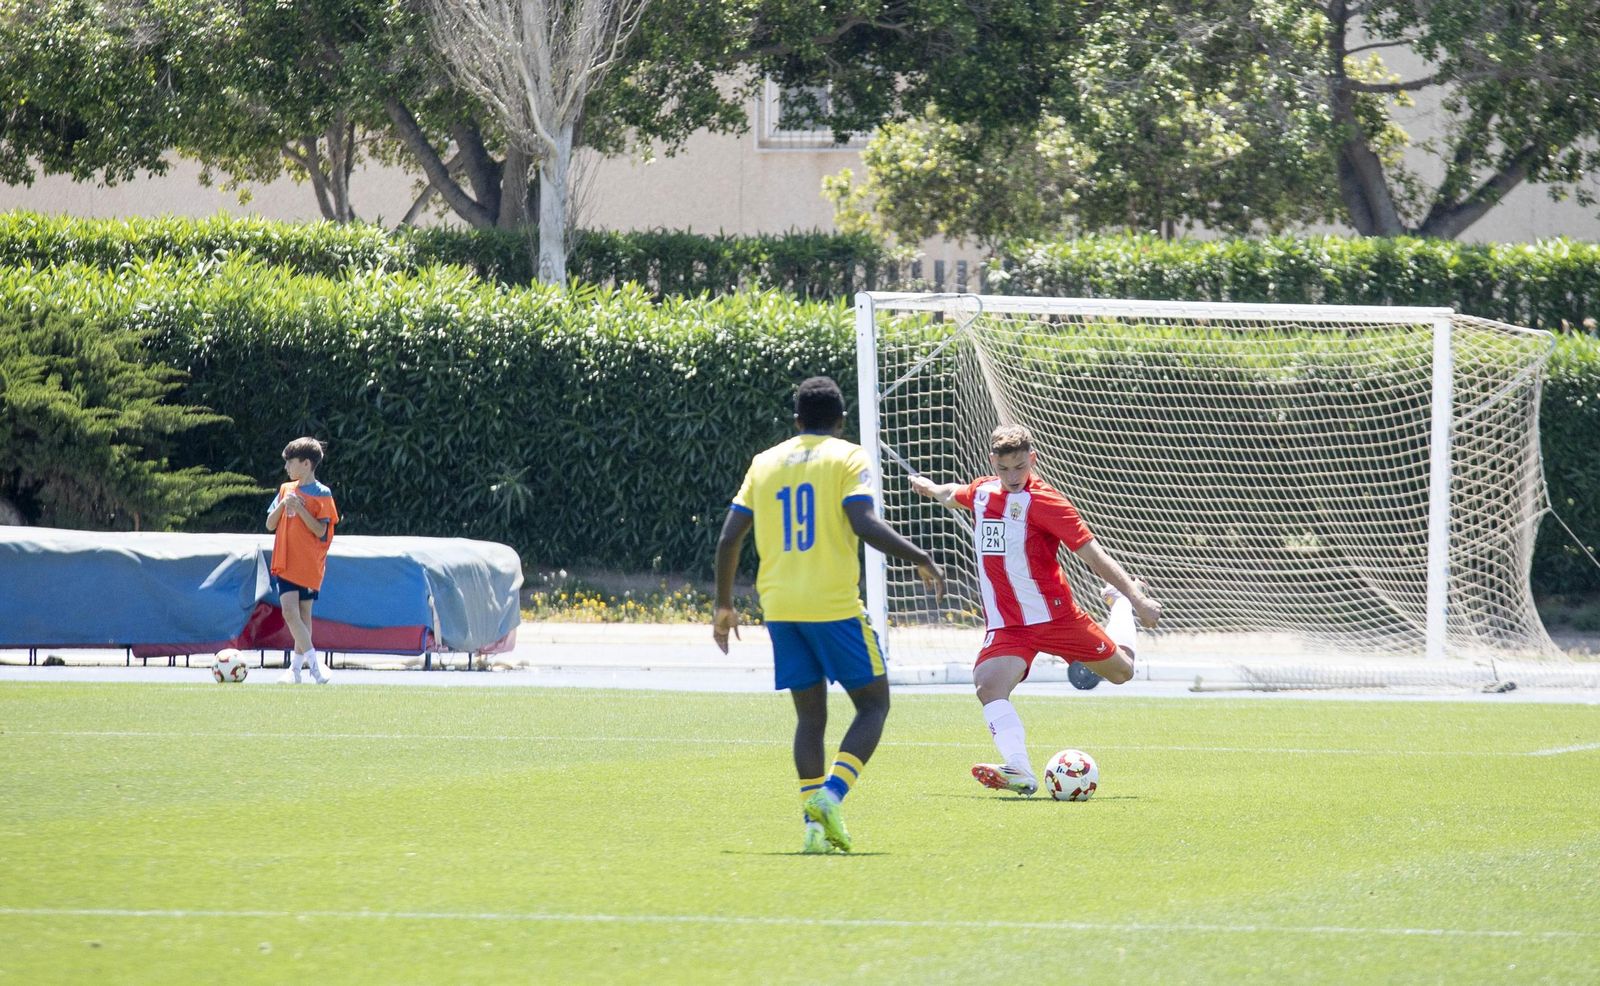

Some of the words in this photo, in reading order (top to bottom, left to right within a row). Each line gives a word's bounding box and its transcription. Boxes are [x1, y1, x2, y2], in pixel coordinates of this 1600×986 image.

[775, 482, 815, 552] 19
[986, 526, 999, 536] DA
[986, 538, 1000, 548] ZN
